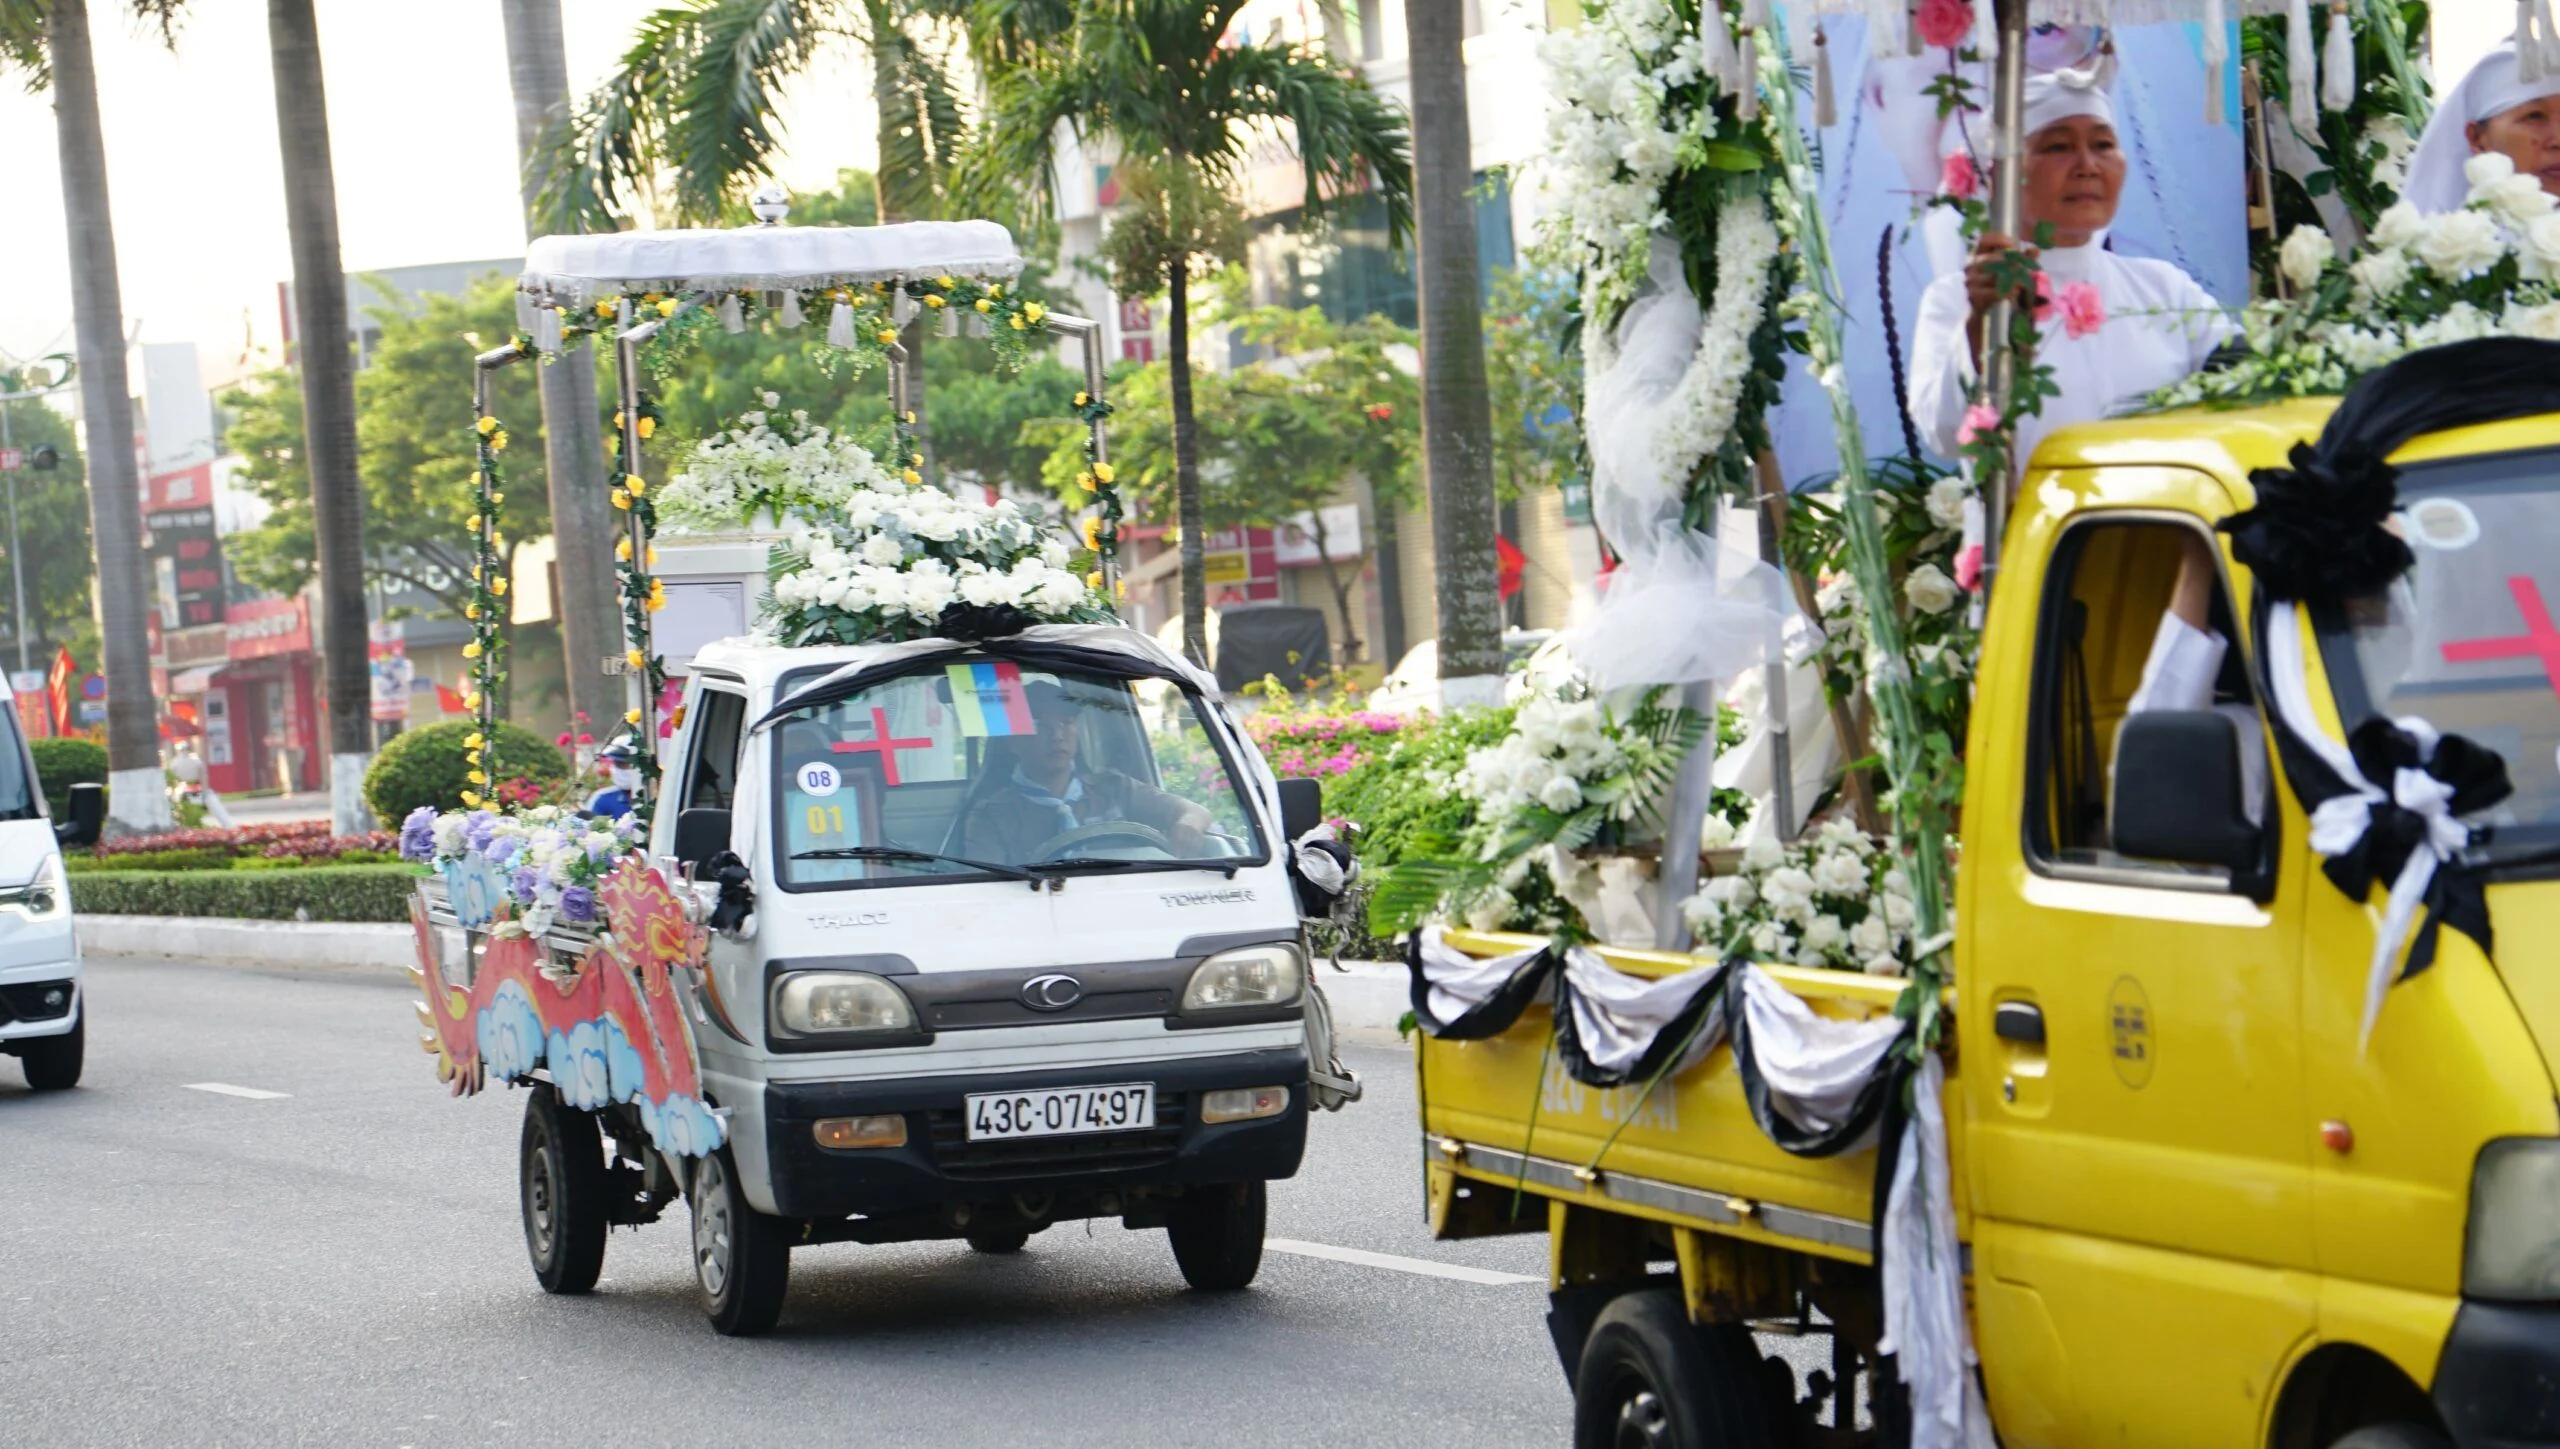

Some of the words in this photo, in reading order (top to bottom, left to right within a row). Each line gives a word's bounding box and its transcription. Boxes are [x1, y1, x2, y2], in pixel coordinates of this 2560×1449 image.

[807, 770, 831, 788] 08
[806, 804, 843, 835] 01
[1159, 888, 1257, 908] TOWNER
[807, 911, 892, 930] THACO
[975, 1089, 1148, 1135] 43C-074.97
